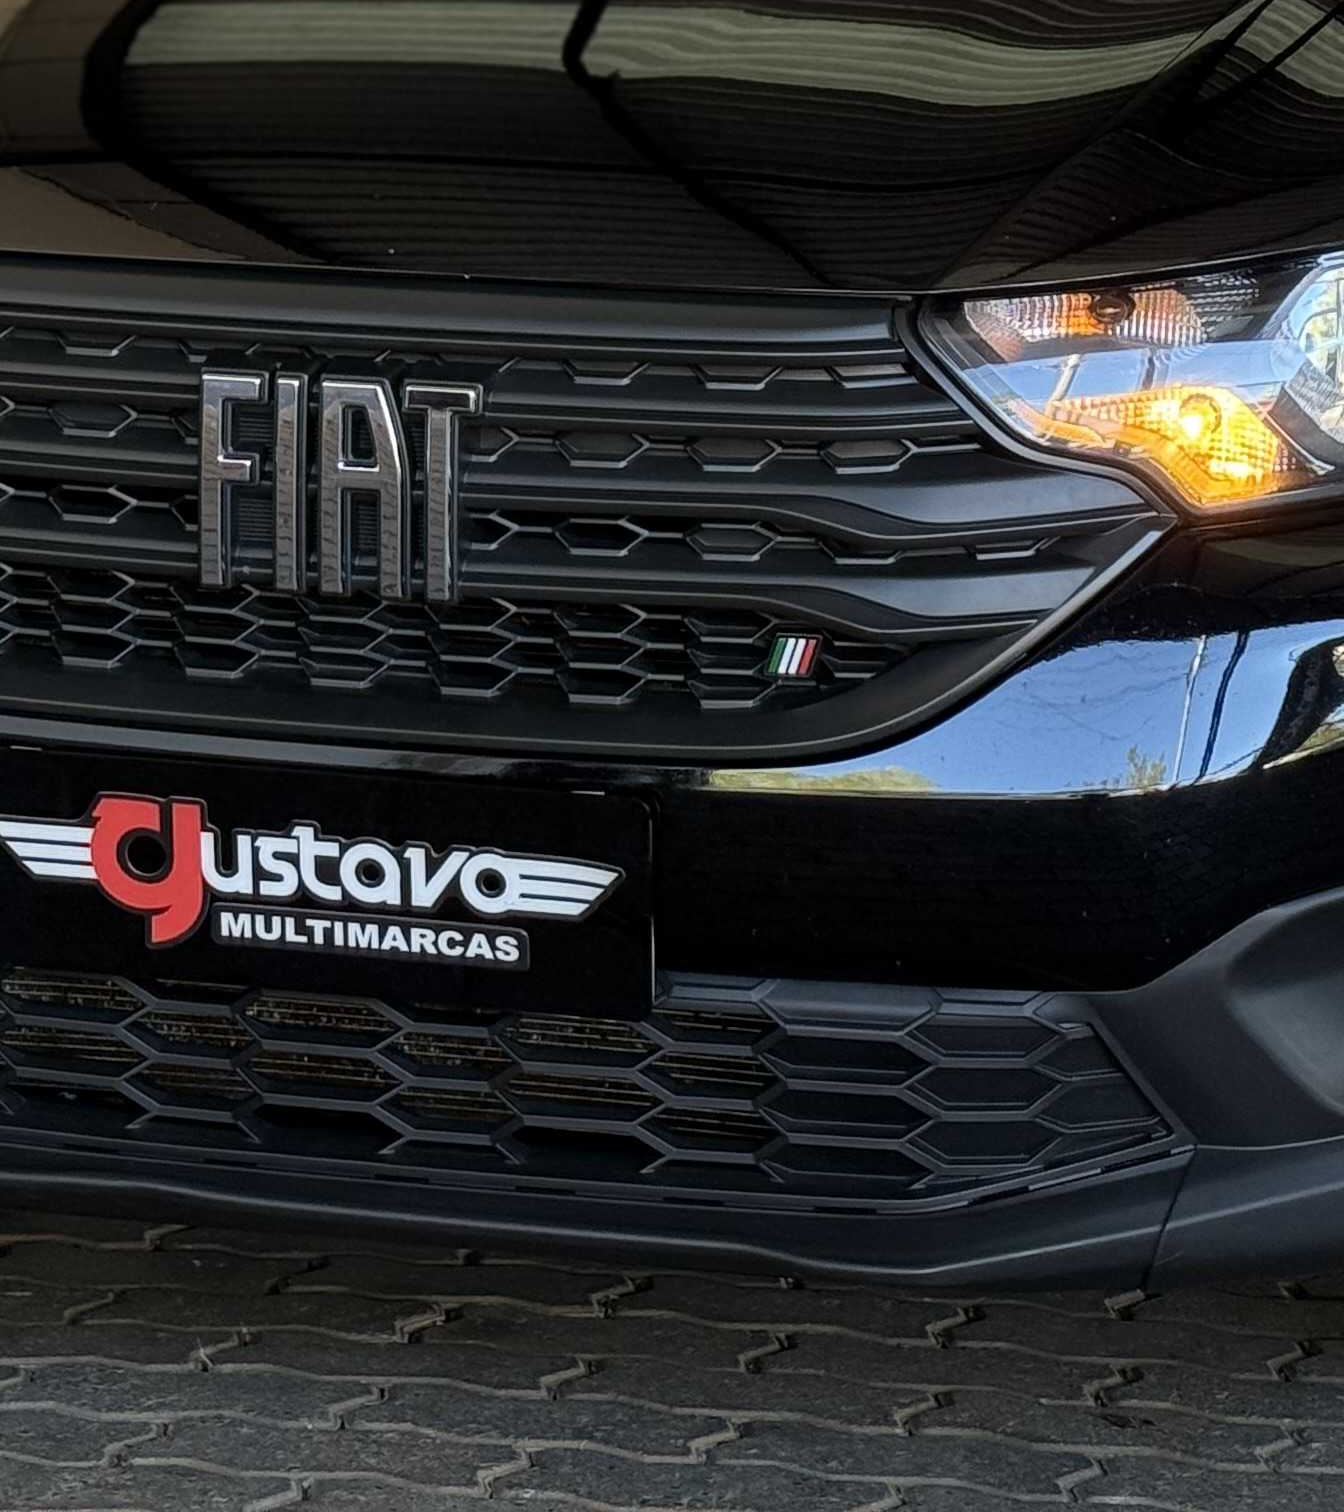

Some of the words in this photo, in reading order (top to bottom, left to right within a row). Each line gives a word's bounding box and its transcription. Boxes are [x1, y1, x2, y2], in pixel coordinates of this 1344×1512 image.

[200, 368, 483, 602] FIAT
[90, 795, 522, 944] gustavo
[219, 911, 521, 963] MULTIMARCAS
